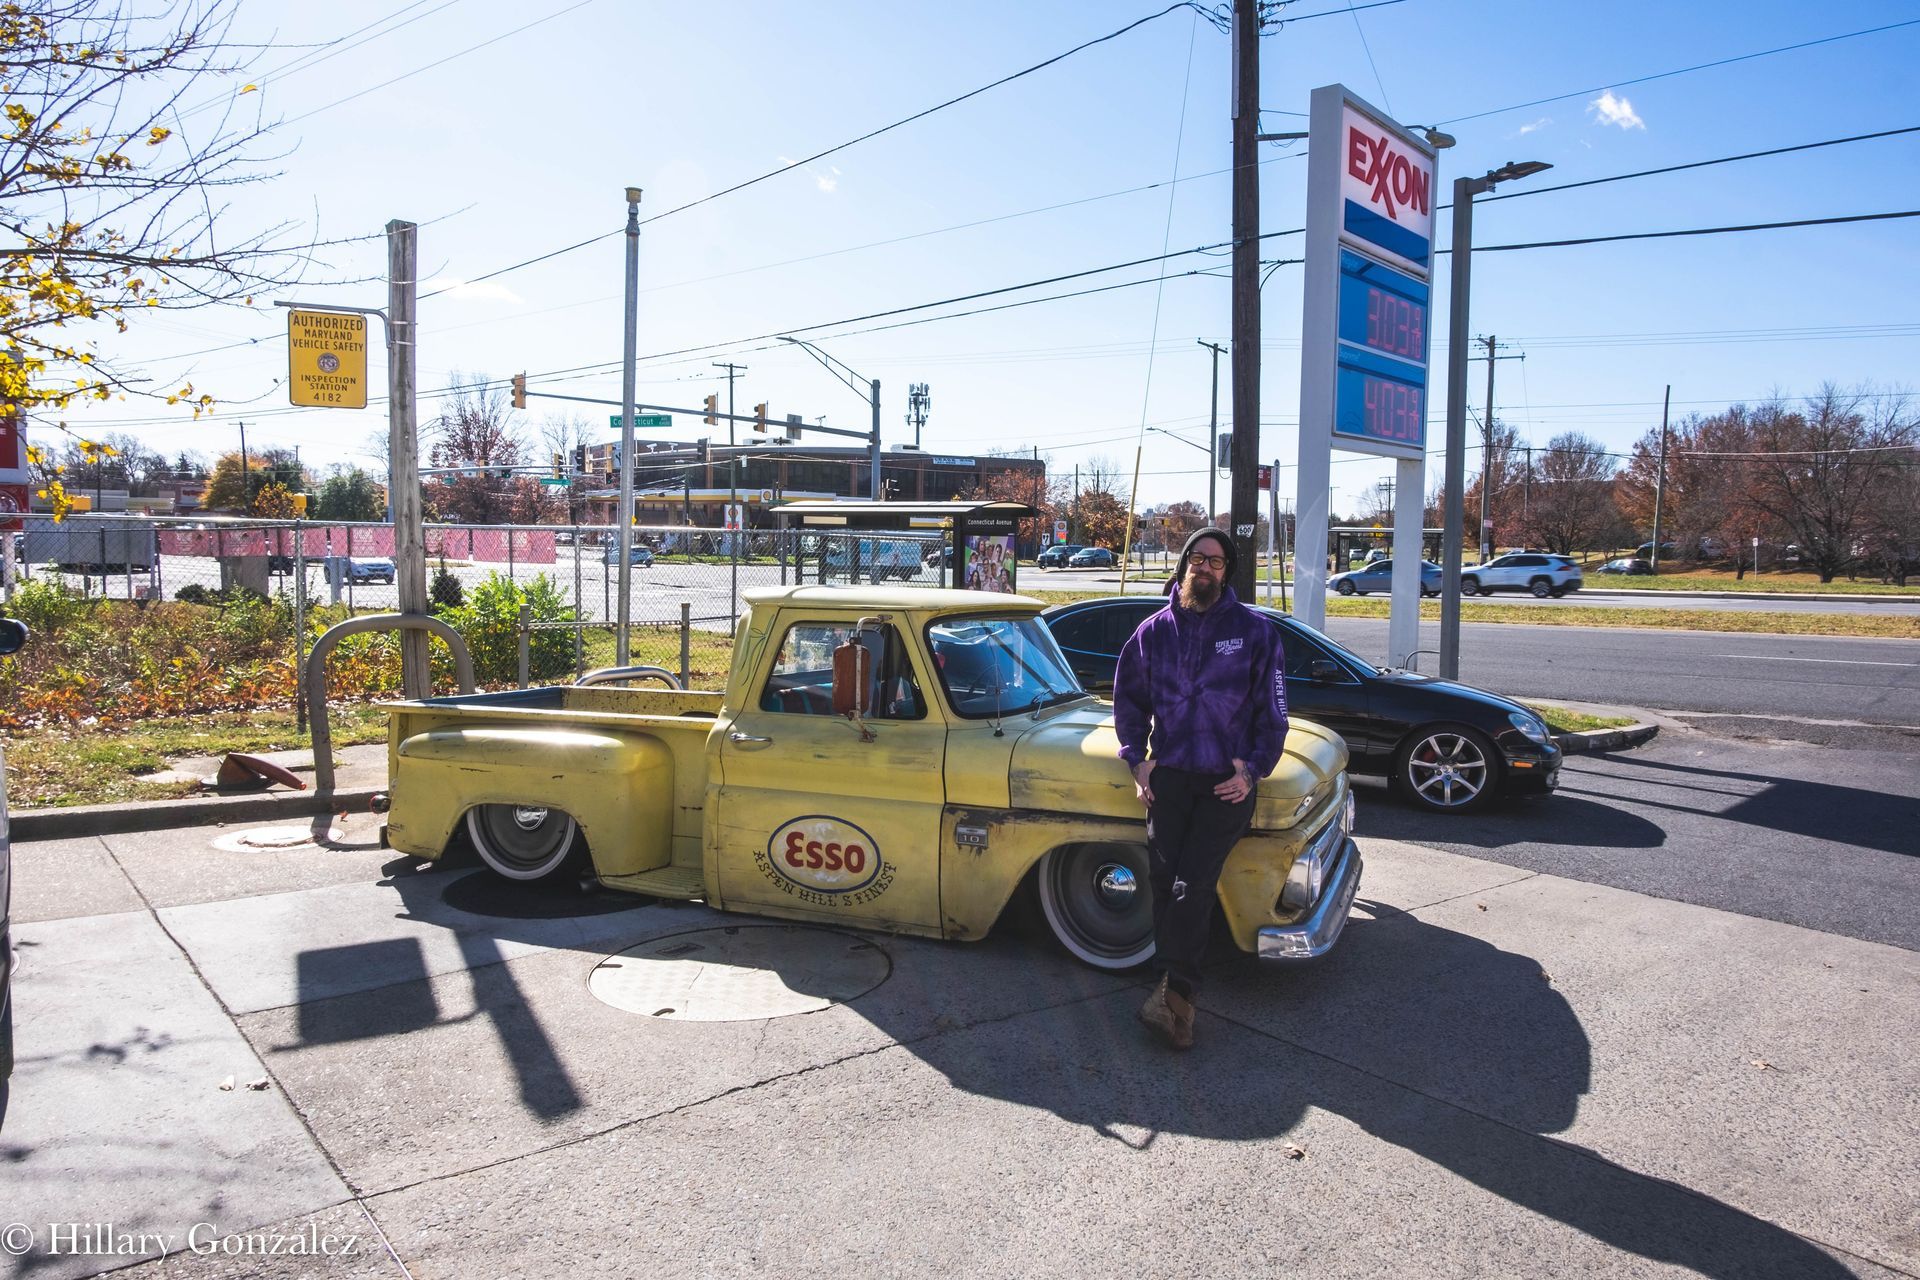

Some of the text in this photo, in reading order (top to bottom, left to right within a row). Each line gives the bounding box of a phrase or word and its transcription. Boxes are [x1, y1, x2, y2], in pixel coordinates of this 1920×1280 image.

[1348, 125, 1430, 220] EXXON
[293, 315, 363, 331] AUTHORIZED
[304, 329, 353, 341] MARYLAND
[292, 338, 364, 352] VEHICLE SAFETY
[301, 374, 357, 385] INSPECTION
[310, 383, 348, 392] STATION
[313, 392, 342, 402] 4182
[613, 418, 654, 426] Cocticut
[1274, 669, 1284, 696] ASPEN
[752, 850, 897, 908] ASPEN HILL'S FINEST
